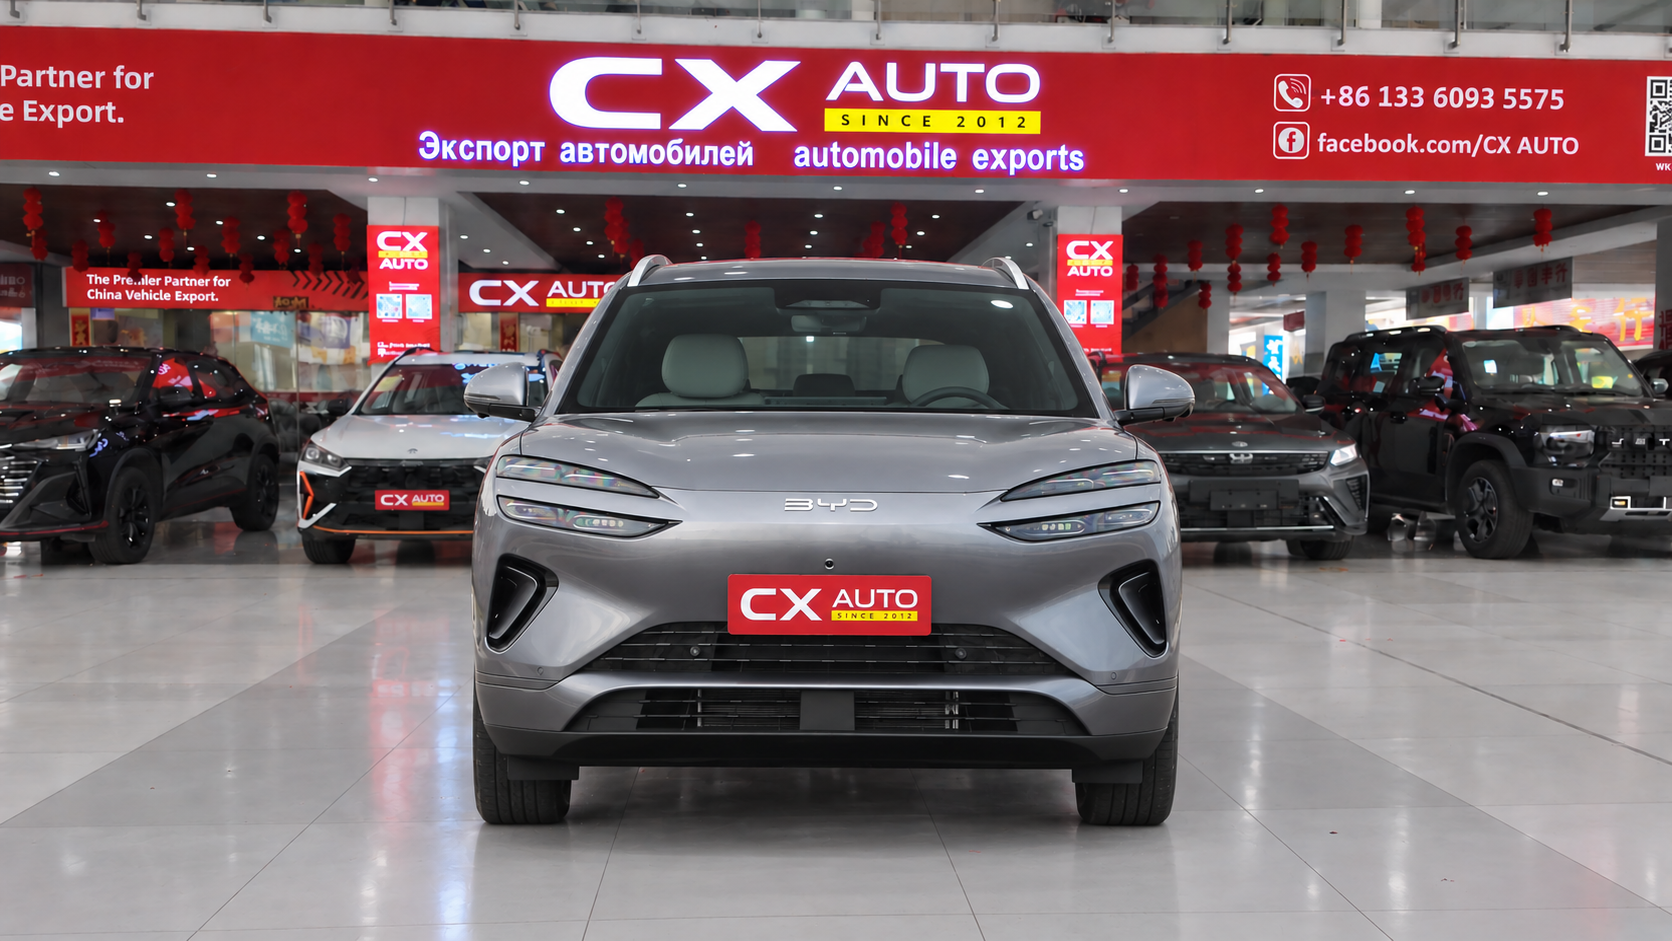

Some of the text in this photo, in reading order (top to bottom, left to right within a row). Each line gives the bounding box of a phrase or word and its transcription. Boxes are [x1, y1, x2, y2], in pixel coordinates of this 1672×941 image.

[1, 65, 154, 89] Partner for
[550, 58, 1040, 132] CX AUTO
[1321, 86, 1564, 110] +86 133 6093 5575
[23, 100, 124, 128] Export.
[842, 114, 1026, 128] SINCE 2012
[418, 131, 753, 167] Экспорт автомобилей
[1317, 132, 1579, 158] facebook.com/CX AUTO
[794, 141, 1084, 175] automobile exports
[377, 230, 428, 251] CX
[1066, 240, 1113, 260] CX
[379, 258, 428, 270] AUTO
[1067, 266, 1113, 277] AUTO
[86, 274, 110, 285] The
[164, 276, 210, 287] Partner
[213, 276, 231, 287] for
[86, 289, 219, 304] China Vehicle Export.
[469, 280, 540, 306] CX
[380, 494, 445, 506] CX AUTO
[784, 498, 878, 512] BYD
[740, 588, 918, 621] CX AUTO
